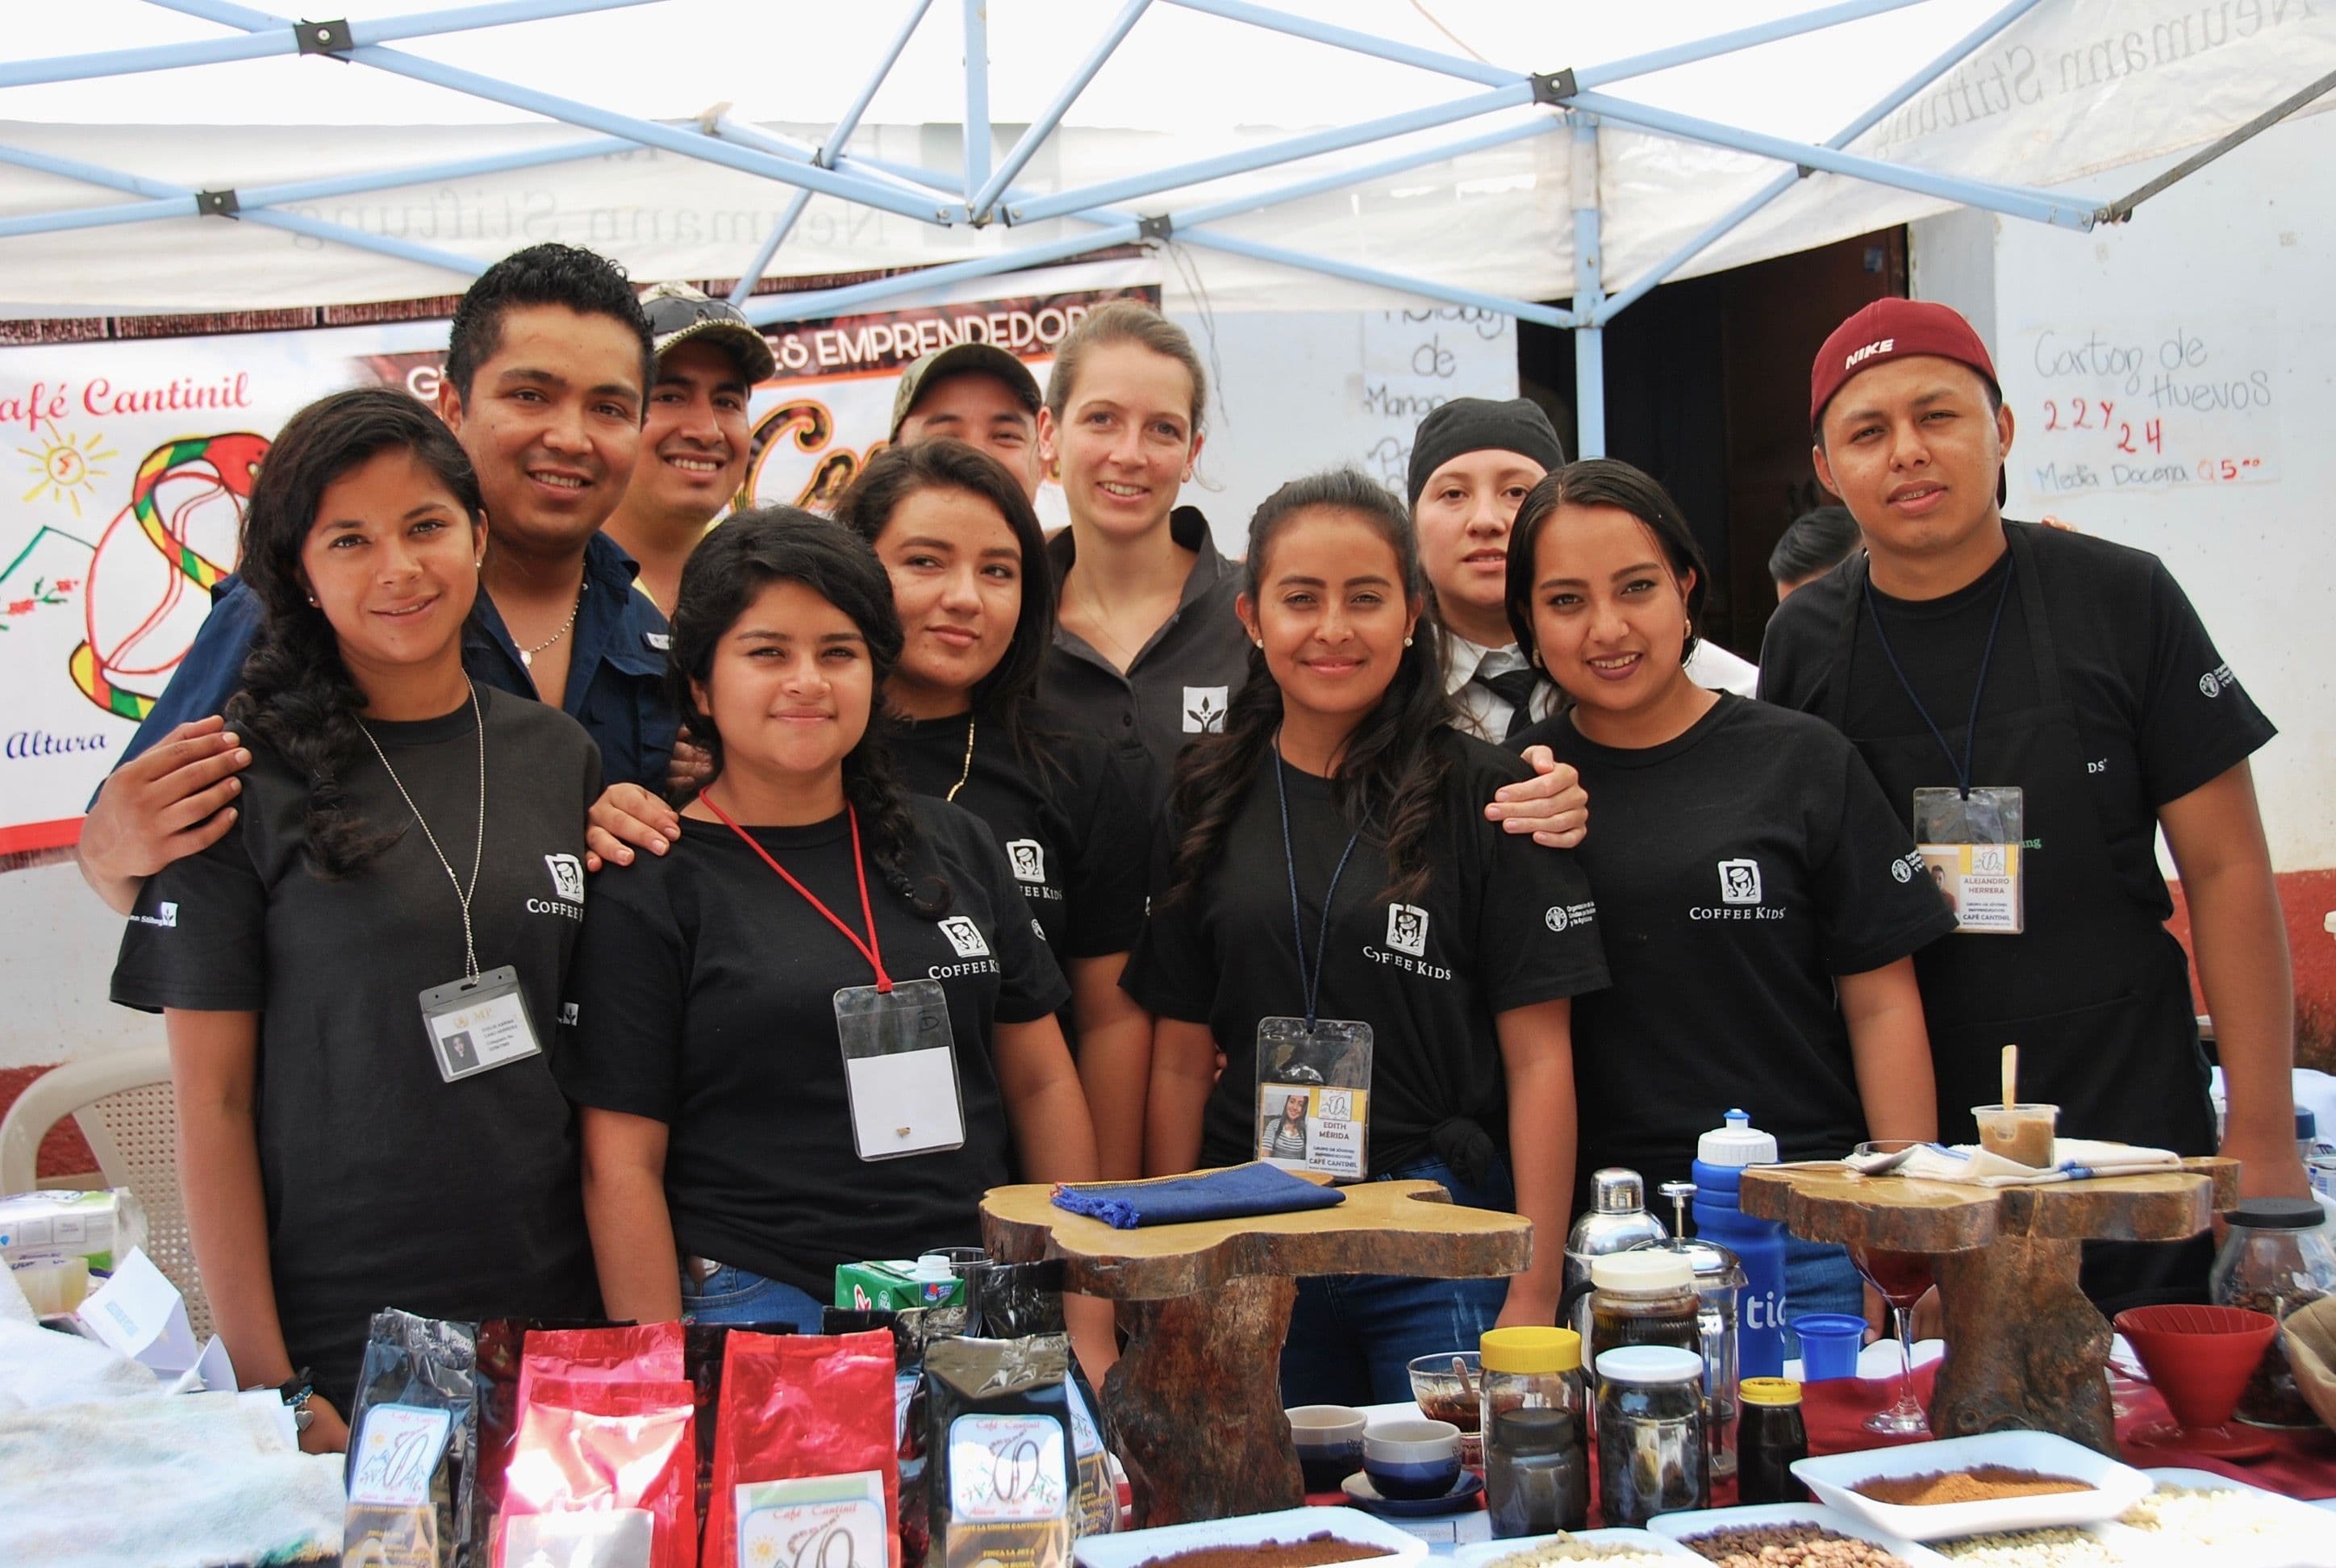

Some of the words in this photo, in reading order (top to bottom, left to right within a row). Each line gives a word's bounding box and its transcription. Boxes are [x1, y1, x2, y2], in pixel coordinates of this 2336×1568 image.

[1412, 332, 1456, 377] de
[1845, 338, 1894, 370] NIKE
[2159, 327, 2208, 370] de
[0, 382, 71, 432] afé
[83, 371, 252, 416] Cantinil
[2117, 418, 2163, 454] 24
[2111, 463, 2190, 486] Docena
[6, 730, 106, 759] Altura
[526, 898, 578, 920] COFFEE
[1689, 907, 1752, 920] COFFEE
[1755, 907, 1786, 920] KIDS
[928, 961, 987, 979] COFFEE
[1416, 961, 1451, 981] KIDS
[1319, 1131, 1349, 1140] MÉRIDA
[1323, 1122, 1347, 1130] EDITH
